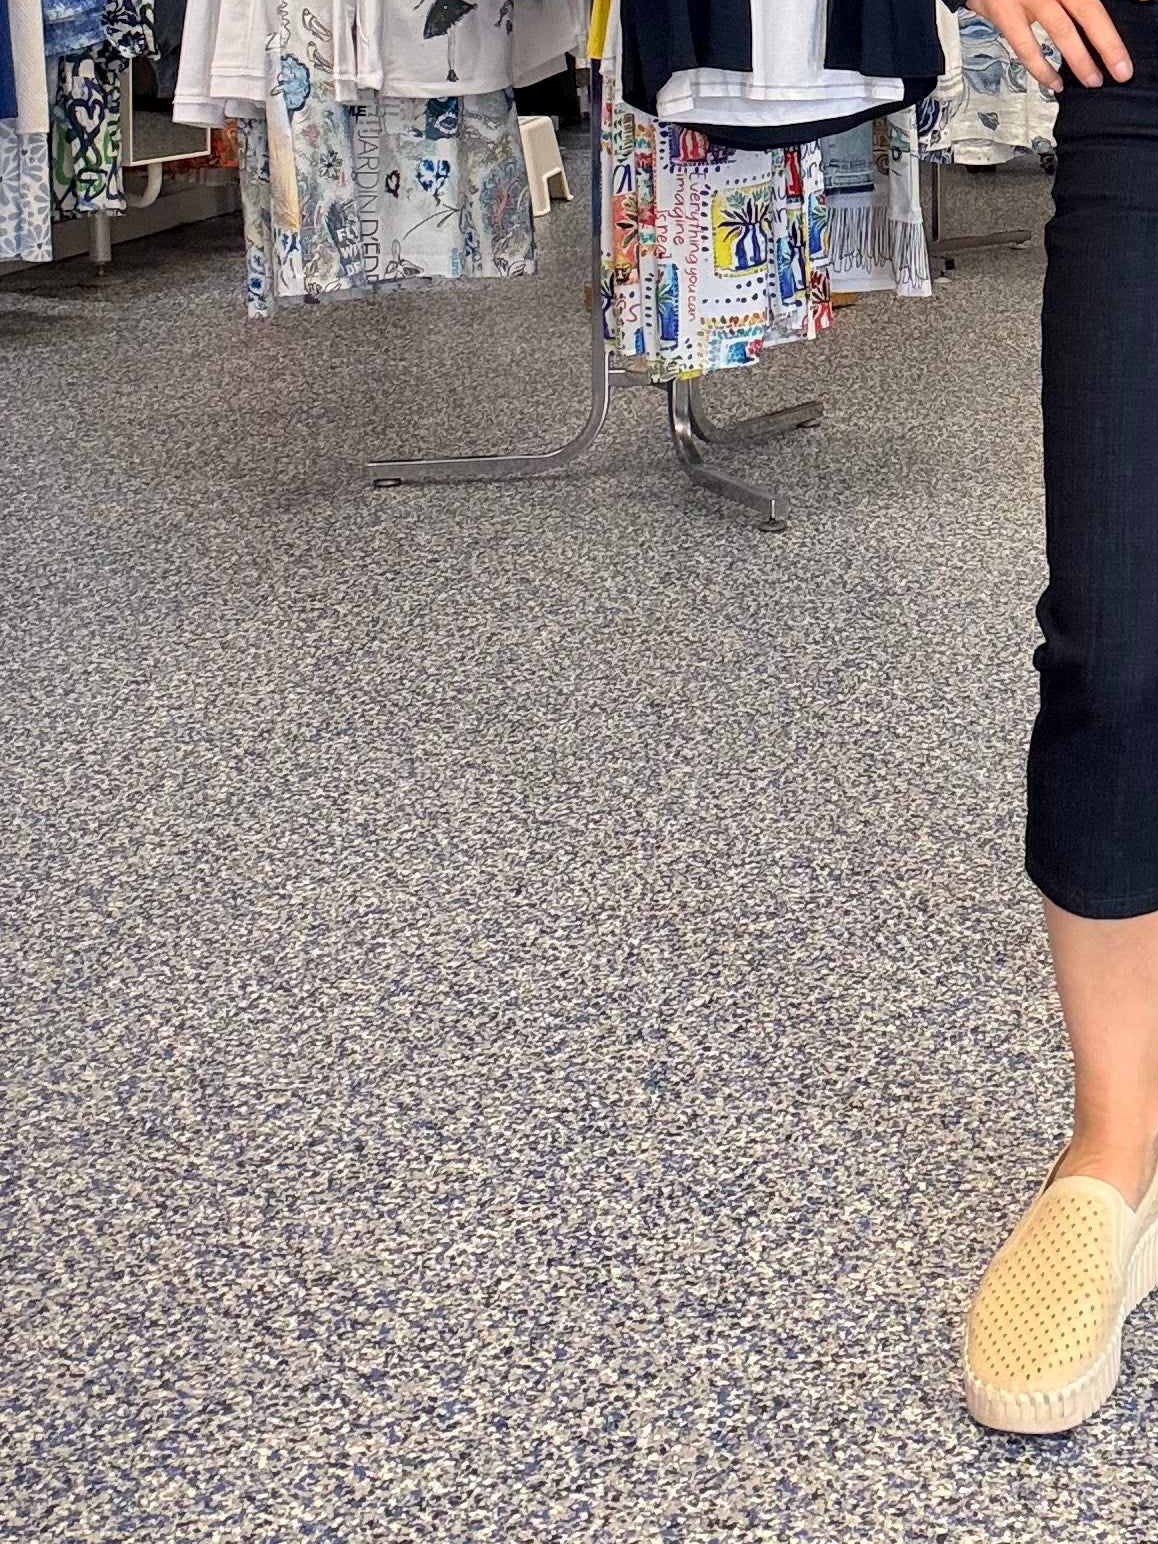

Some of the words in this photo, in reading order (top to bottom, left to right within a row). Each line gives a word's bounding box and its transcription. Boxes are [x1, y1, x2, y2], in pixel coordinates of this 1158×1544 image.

[356, 129, 379, 213] JARDIN
[669, 173, 685, 246] imagine
[684, 172, 707, 265] Everything
[684, 267, 698, 293] you
[687, 295, 697, 322] can
